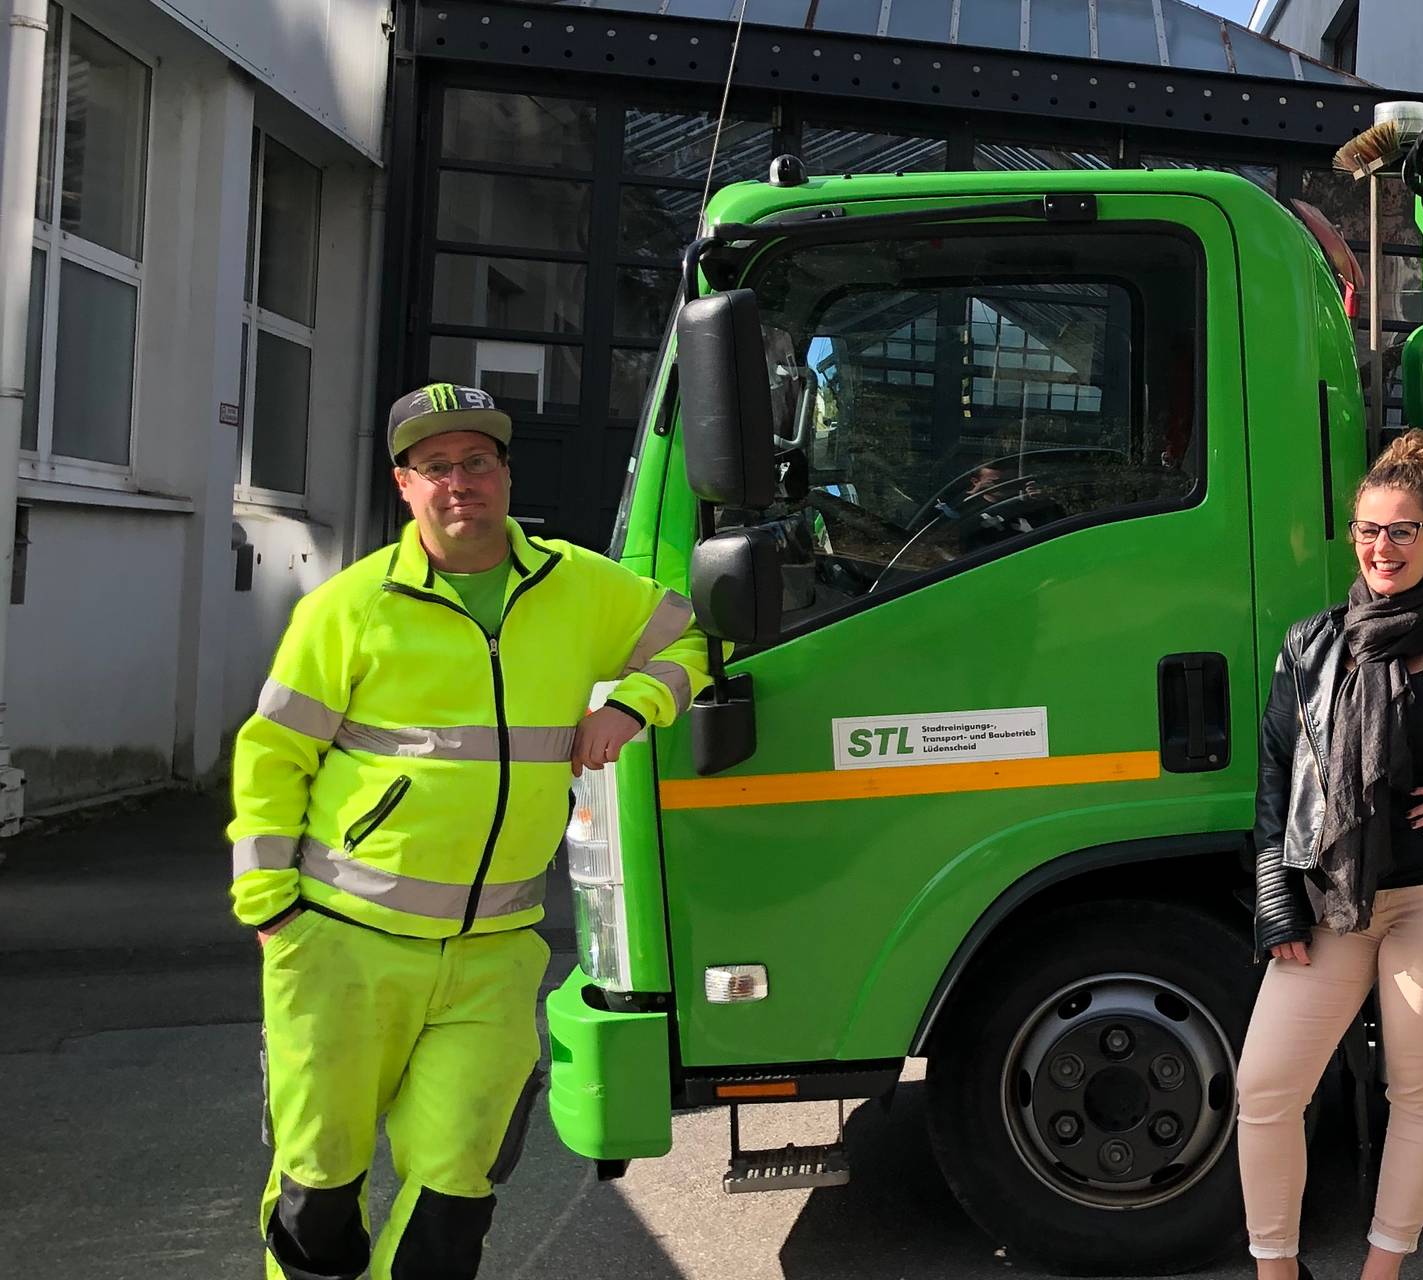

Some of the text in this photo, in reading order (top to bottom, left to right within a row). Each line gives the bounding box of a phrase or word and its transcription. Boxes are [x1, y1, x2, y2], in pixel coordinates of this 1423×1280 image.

[921, 723, 997, 732] Stadtreinigungs-,
[847, 726, 915, 758] STL
[922, 729, 1036, 743] Transport- und Baubetrieb
[923, 743, 977, 753] Lüdenscheid
